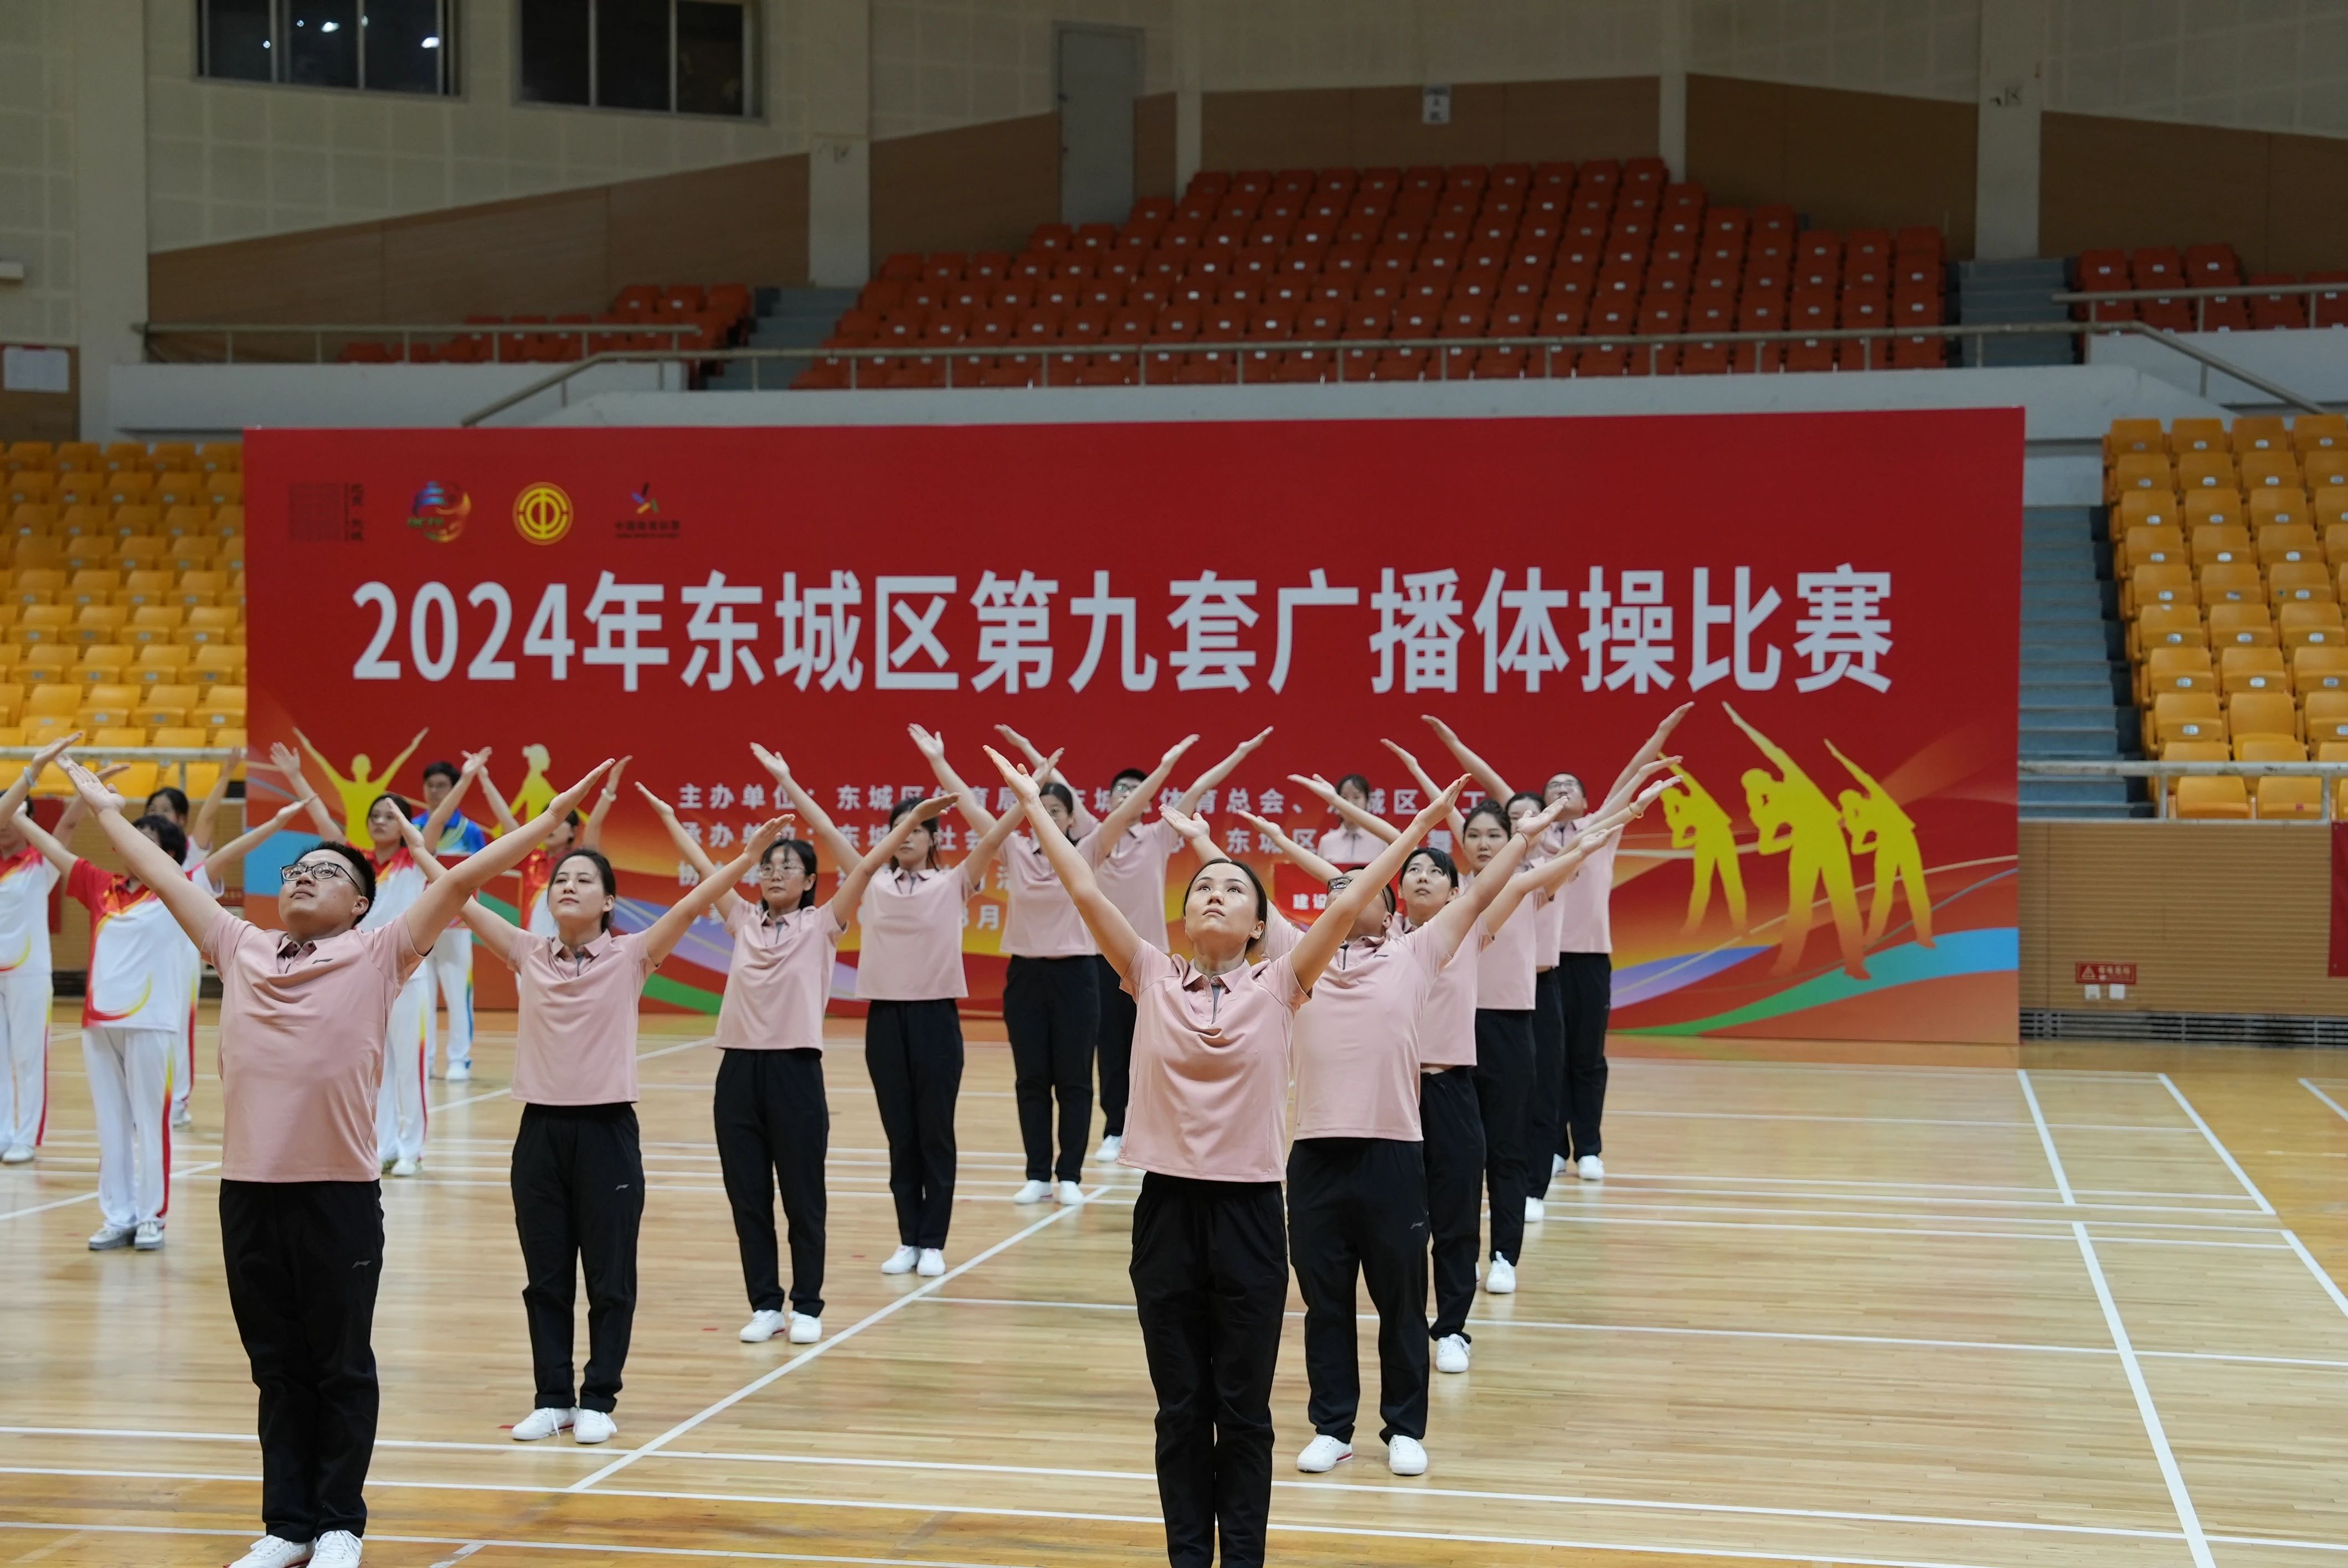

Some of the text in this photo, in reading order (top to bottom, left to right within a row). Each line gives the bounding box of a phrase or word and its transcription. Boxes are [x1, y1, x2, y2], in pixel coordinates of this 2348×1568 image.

[353, 564, 1893, 694] 2024年东城区第九套广播体操比赛
